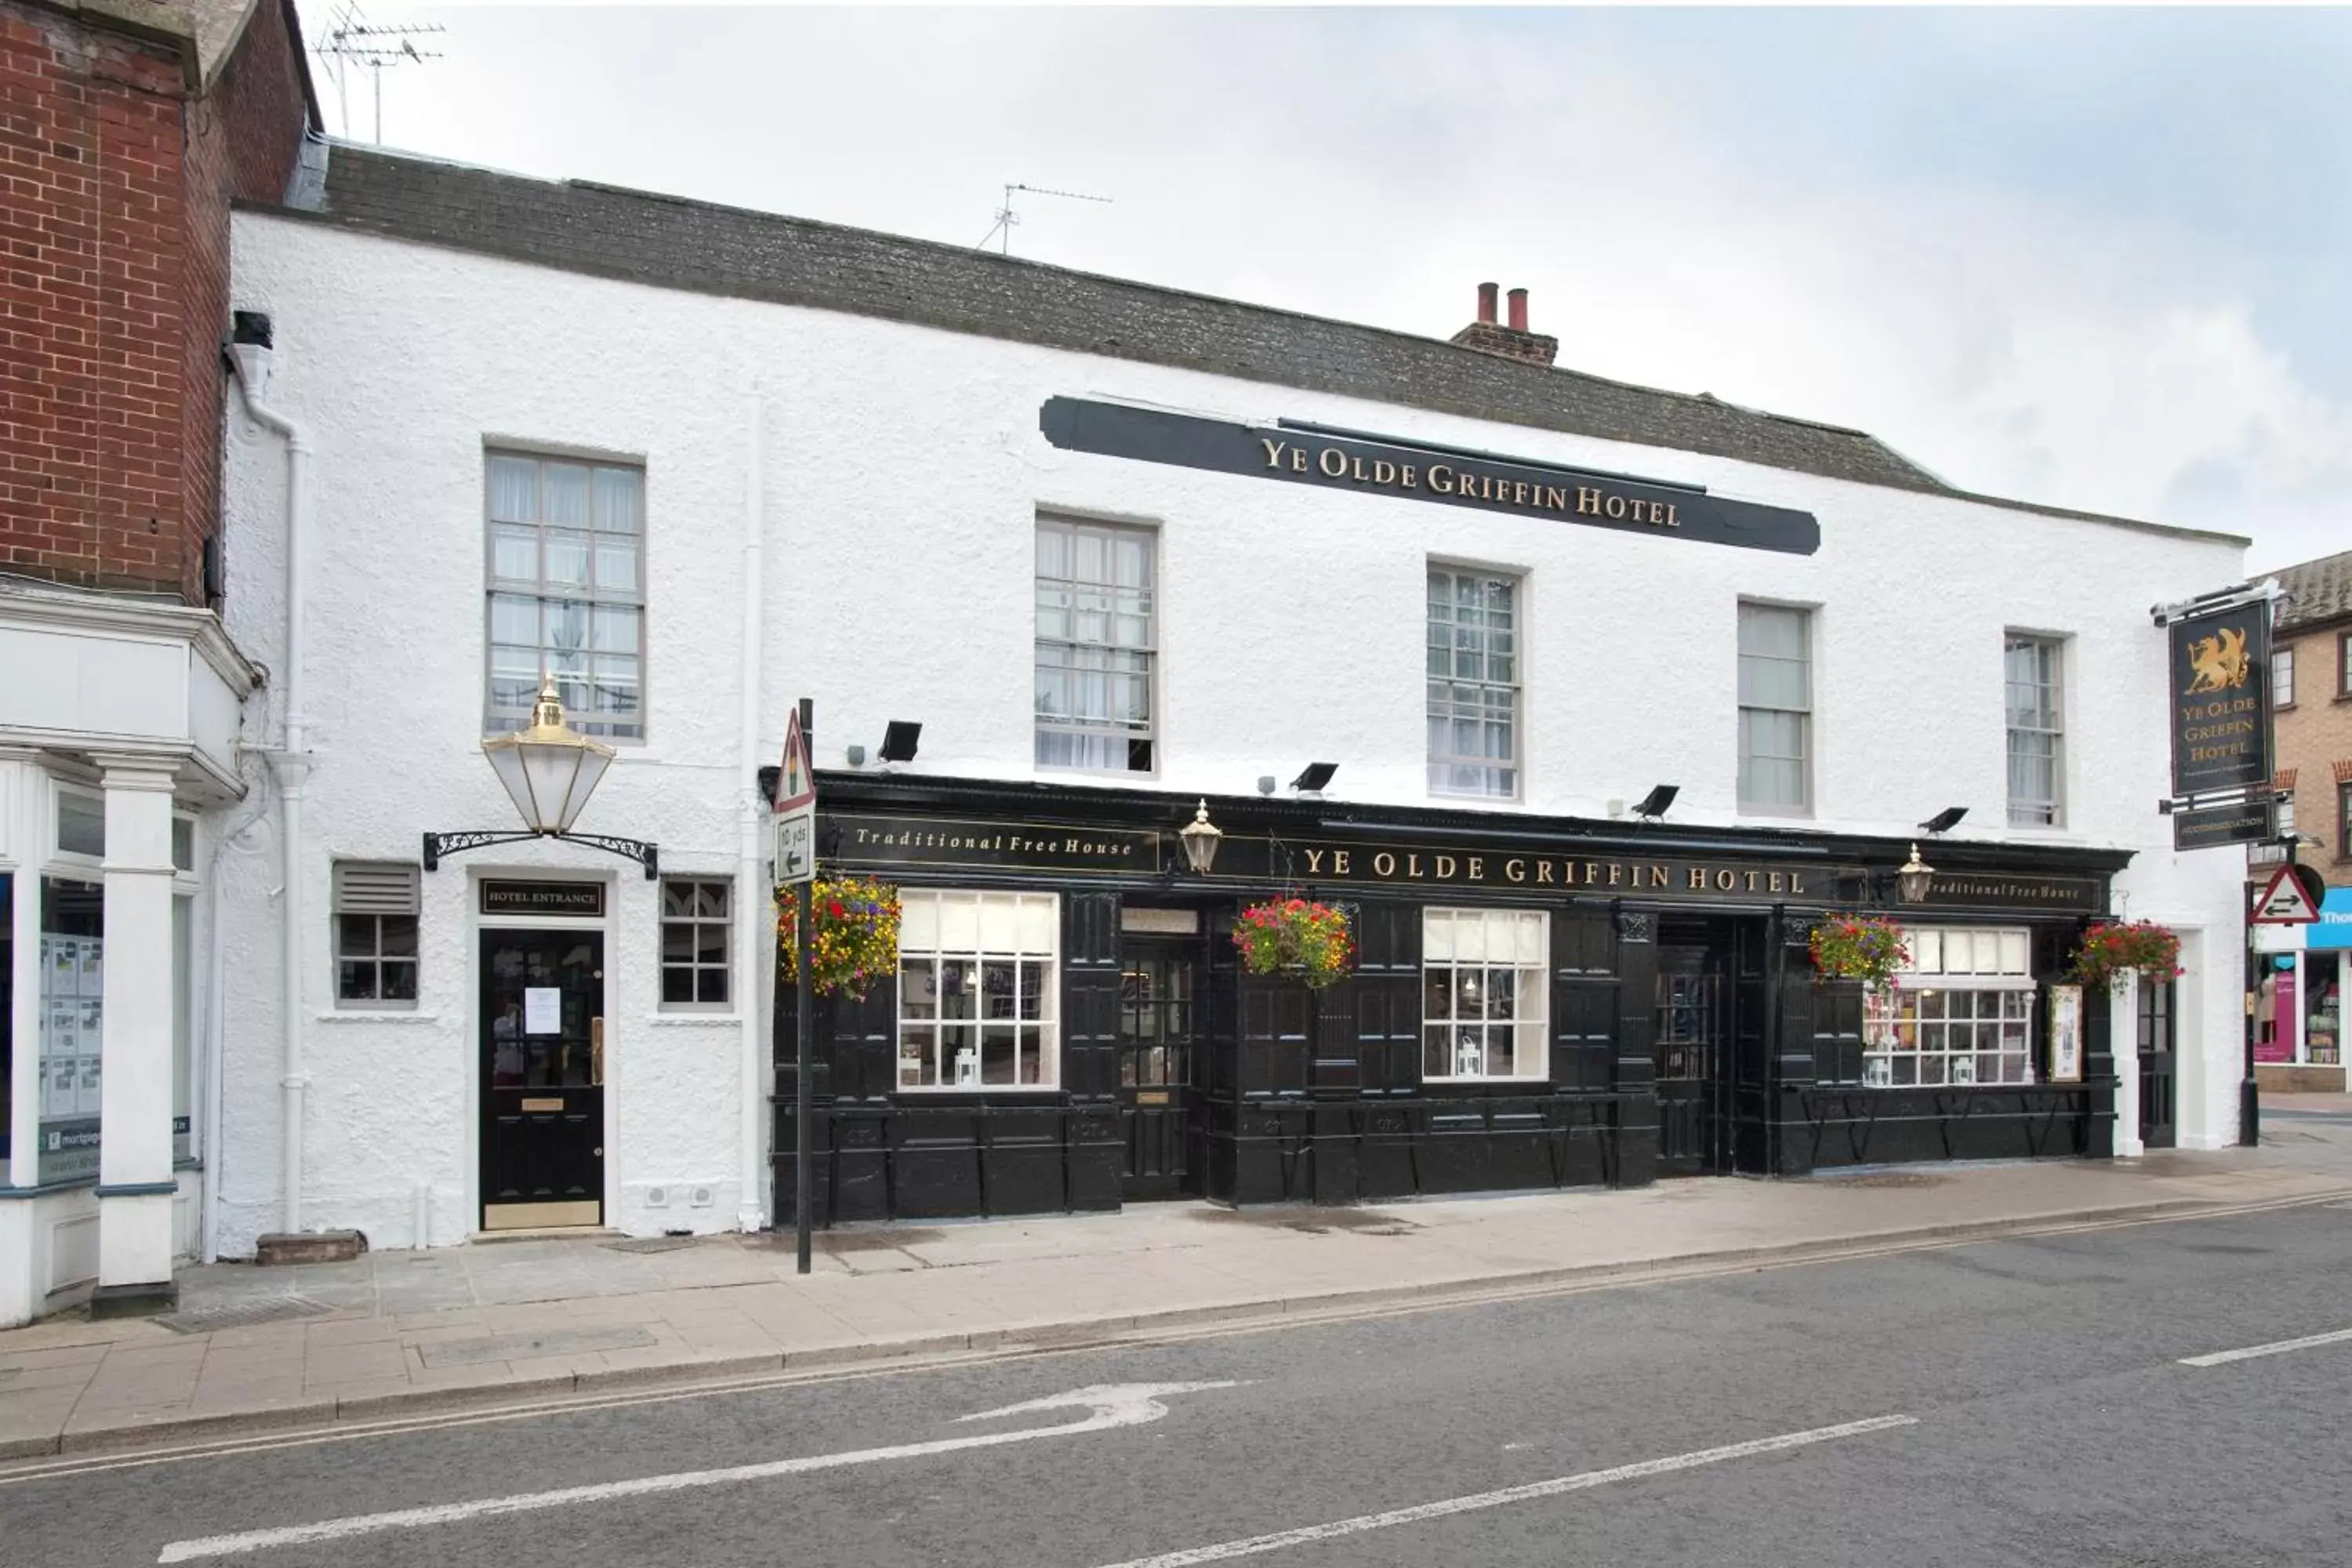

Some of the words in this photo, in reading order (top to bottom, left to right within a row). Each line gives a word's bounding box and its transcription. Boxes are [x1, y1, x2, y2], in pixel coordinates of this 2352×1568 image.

[1319, 448, 1417, 488] OLDE
[1426, 463, 1567, 511] GRIFFIN
[1575, 485, 1681, 528] HOTEL
[856, 829, 1002, 851] Traditional
[1009, 836, 1058, 853] Free
[1064, 838, 1133, 856] House
[1304, 848, 1350, 875] YE
[1373, 851, 1484, 880] OLDE
[1504, 858, 1669, 888] GRIFFIN
[1687, 866, 1805, 894] HOTEL
[488, 891, 531, 902] HOTEL
[532, 892, 597, 905] ENTRANCE
